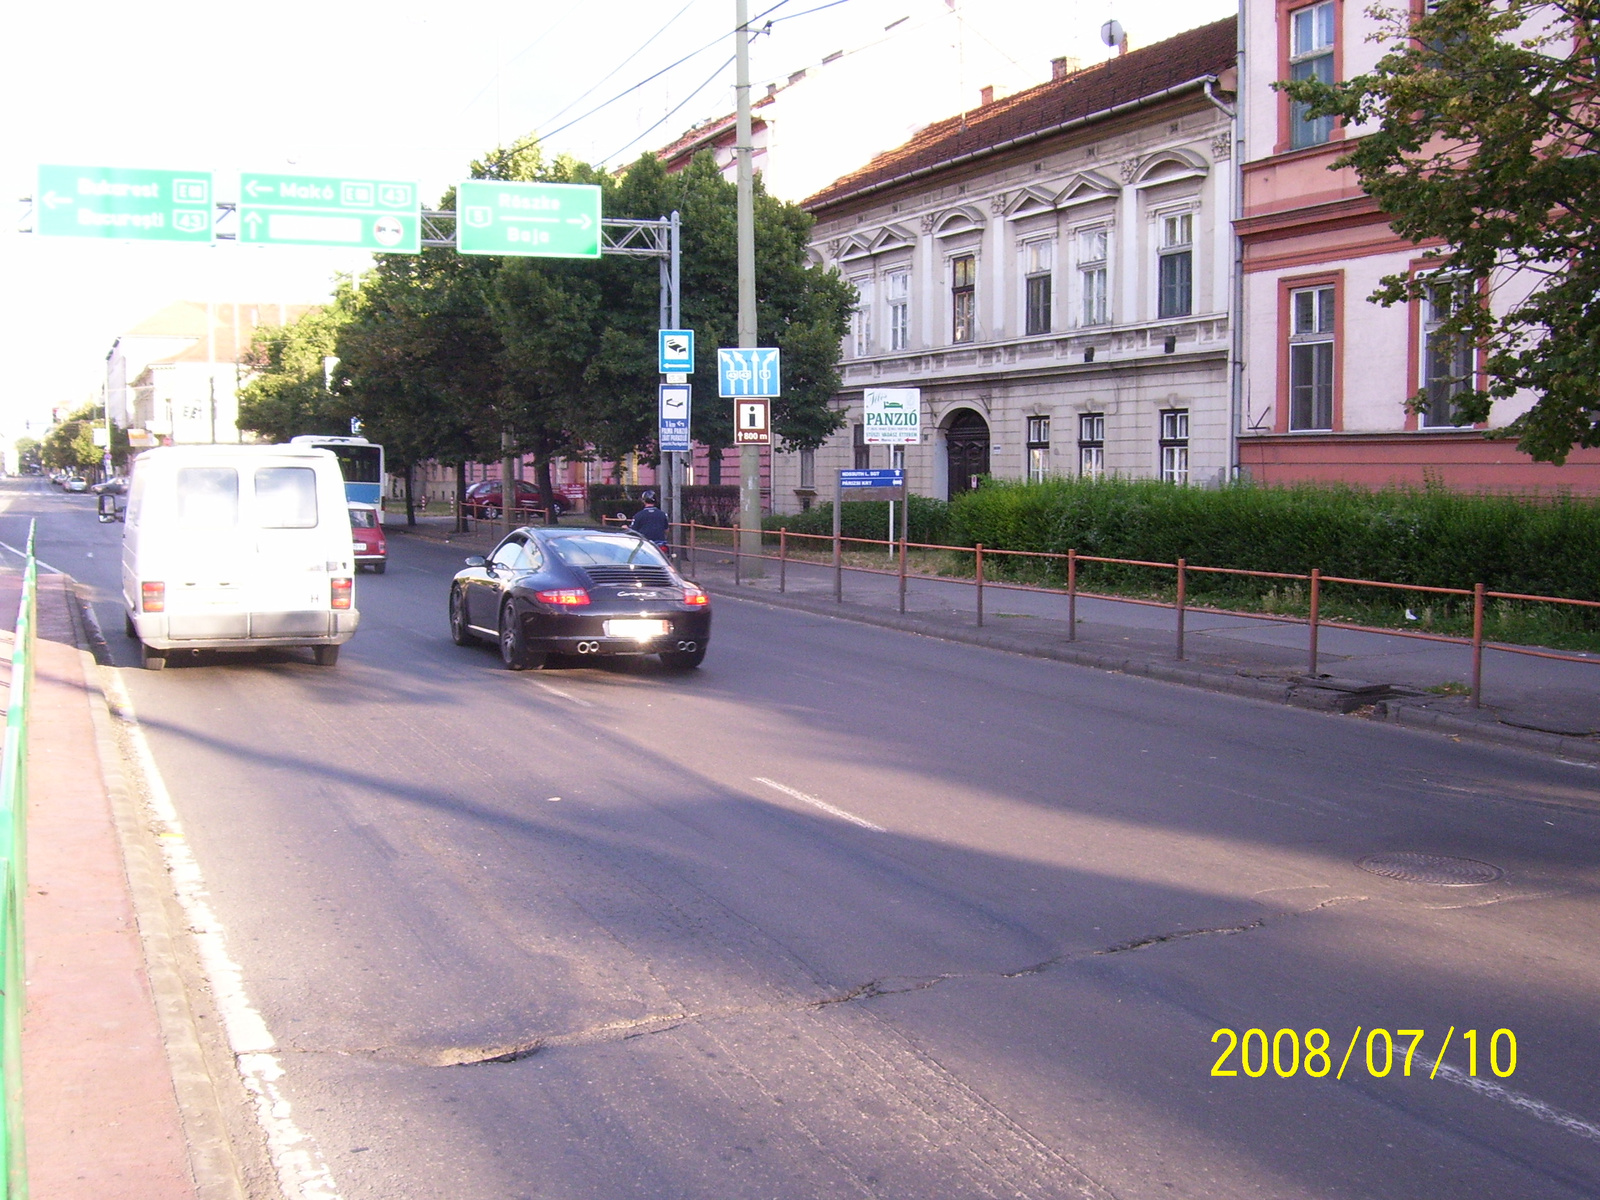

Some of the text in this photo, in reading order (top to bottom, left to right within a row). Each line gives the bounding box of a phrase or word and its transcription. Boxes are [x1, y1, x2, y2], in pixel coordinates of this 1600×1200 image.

[280, 182, 334, 200] Makó
[384, 189, 405, 202] 43
[507, 226, 550, 246] Baja
[866, 409, 918, 426] PANZIÓ
[743, 432, 758, 440] 800
